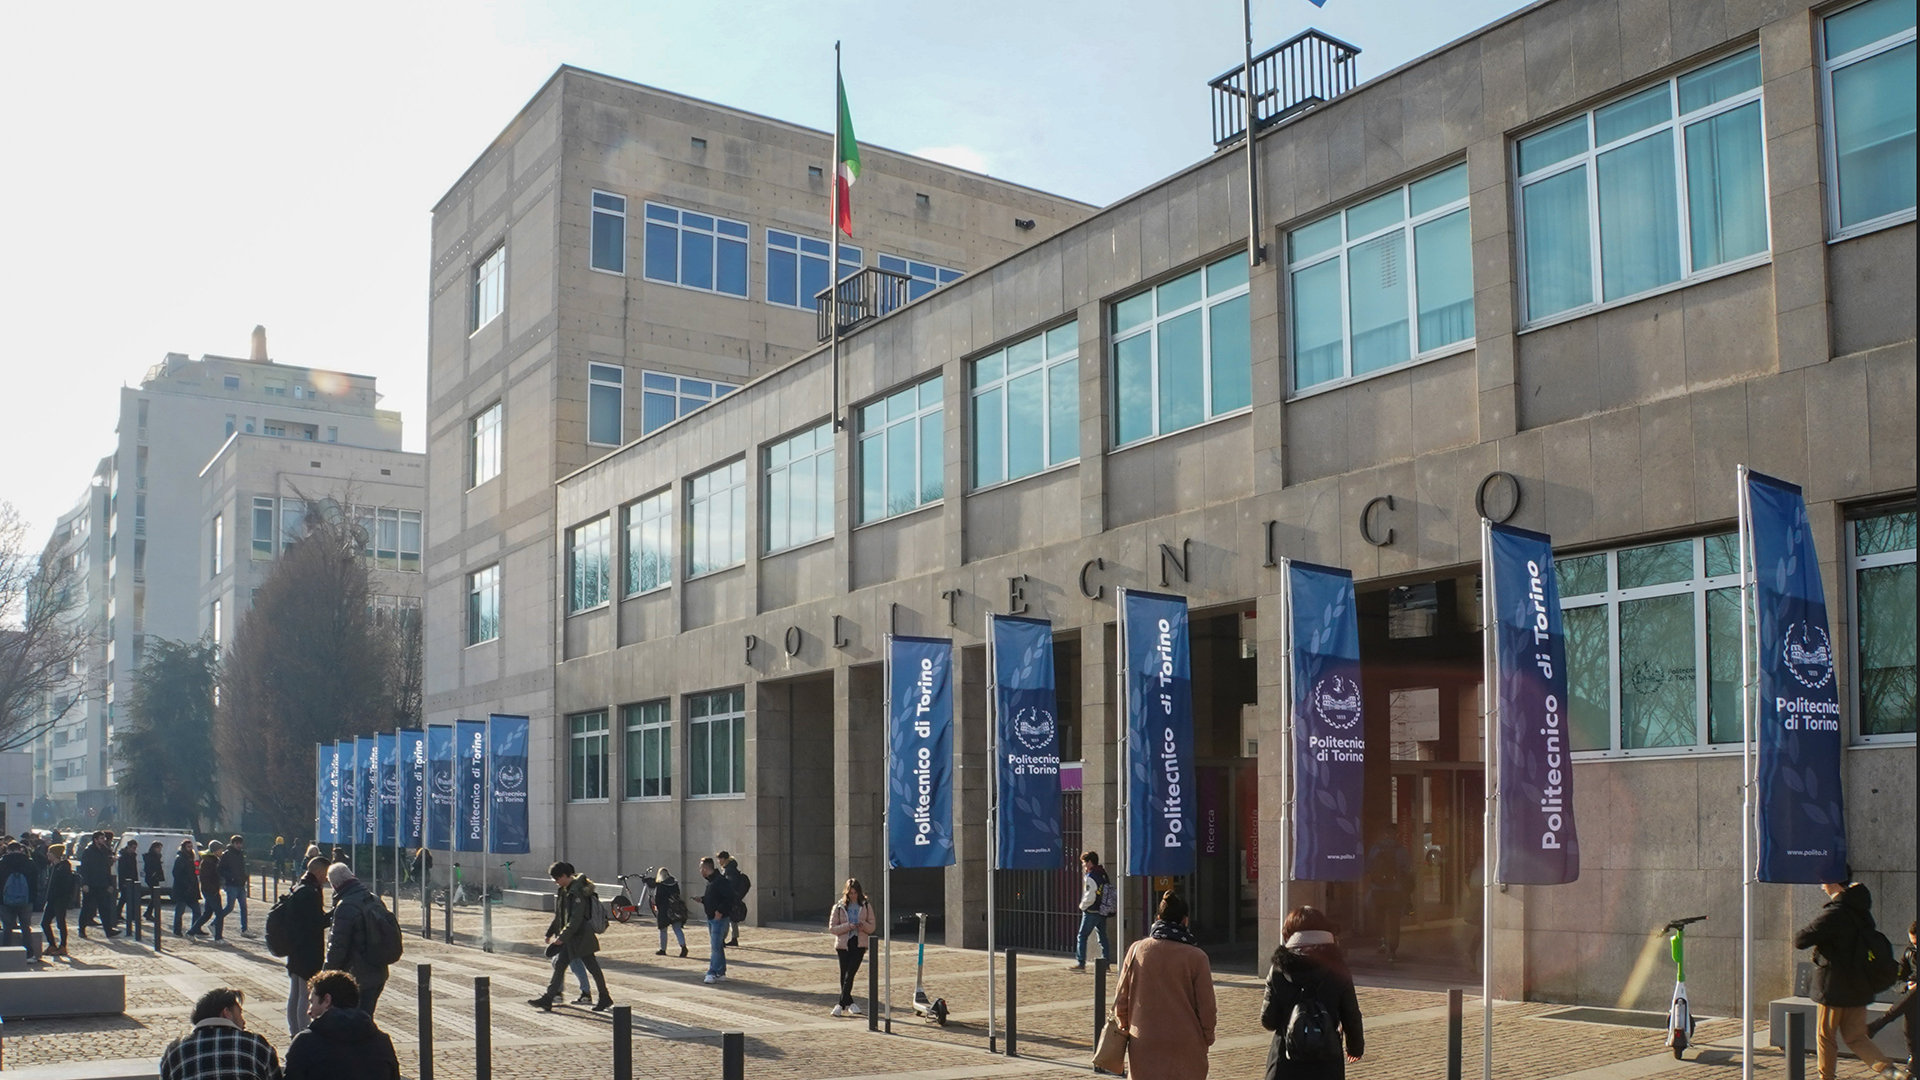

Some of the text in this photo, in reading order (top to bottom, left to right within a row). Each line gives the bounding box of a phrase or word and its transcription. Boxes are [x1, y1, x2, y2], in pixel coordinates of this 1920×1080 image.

[744, 470, 1522, 667] POLITECNICO
[1157, 618, 1183, 848] Politecnico di Torino
[1526, 559, 1562, 851] Politecnico di Torino
[1784, 714, 1839, 731] di Torino
[470, 732, 482, 840] Politecnico di Torino
[913, 658, 933, 846] Politecnico di Torino
[1008, 753, 1061, 764] Politecnico
[1014, 764, 1058, 775] di Torino
[1316, 749, 1364, 762] di Torino
[413, 740, 423, 838] Politecnico di Torino
[1206, 808, 1215, 853] Ricerca
[1786, 848, 1828, 857] www.polito.it
